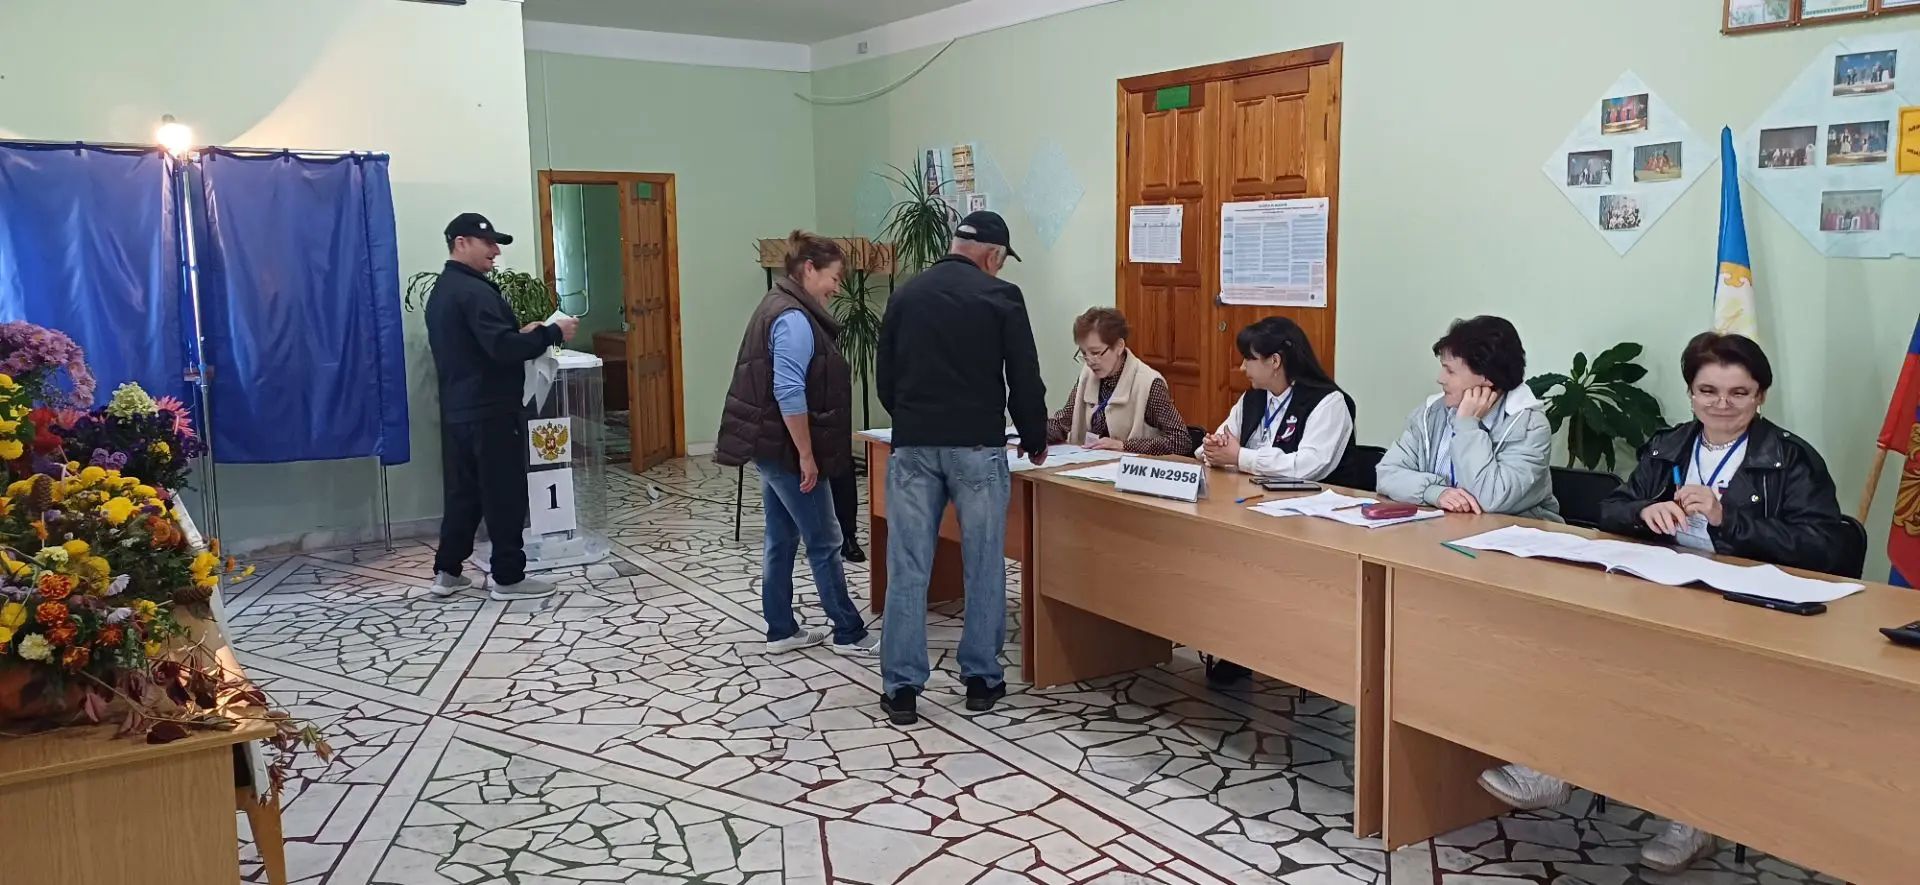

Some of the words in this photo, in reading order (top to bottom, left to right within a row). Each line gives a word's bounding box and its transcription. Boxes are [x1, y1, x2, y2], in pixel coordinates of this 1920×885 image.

[1122, 463, 1148, 477] УИК
[1150, 467, 1198, 484] №2958
[546, 483, 561, 510] 1
